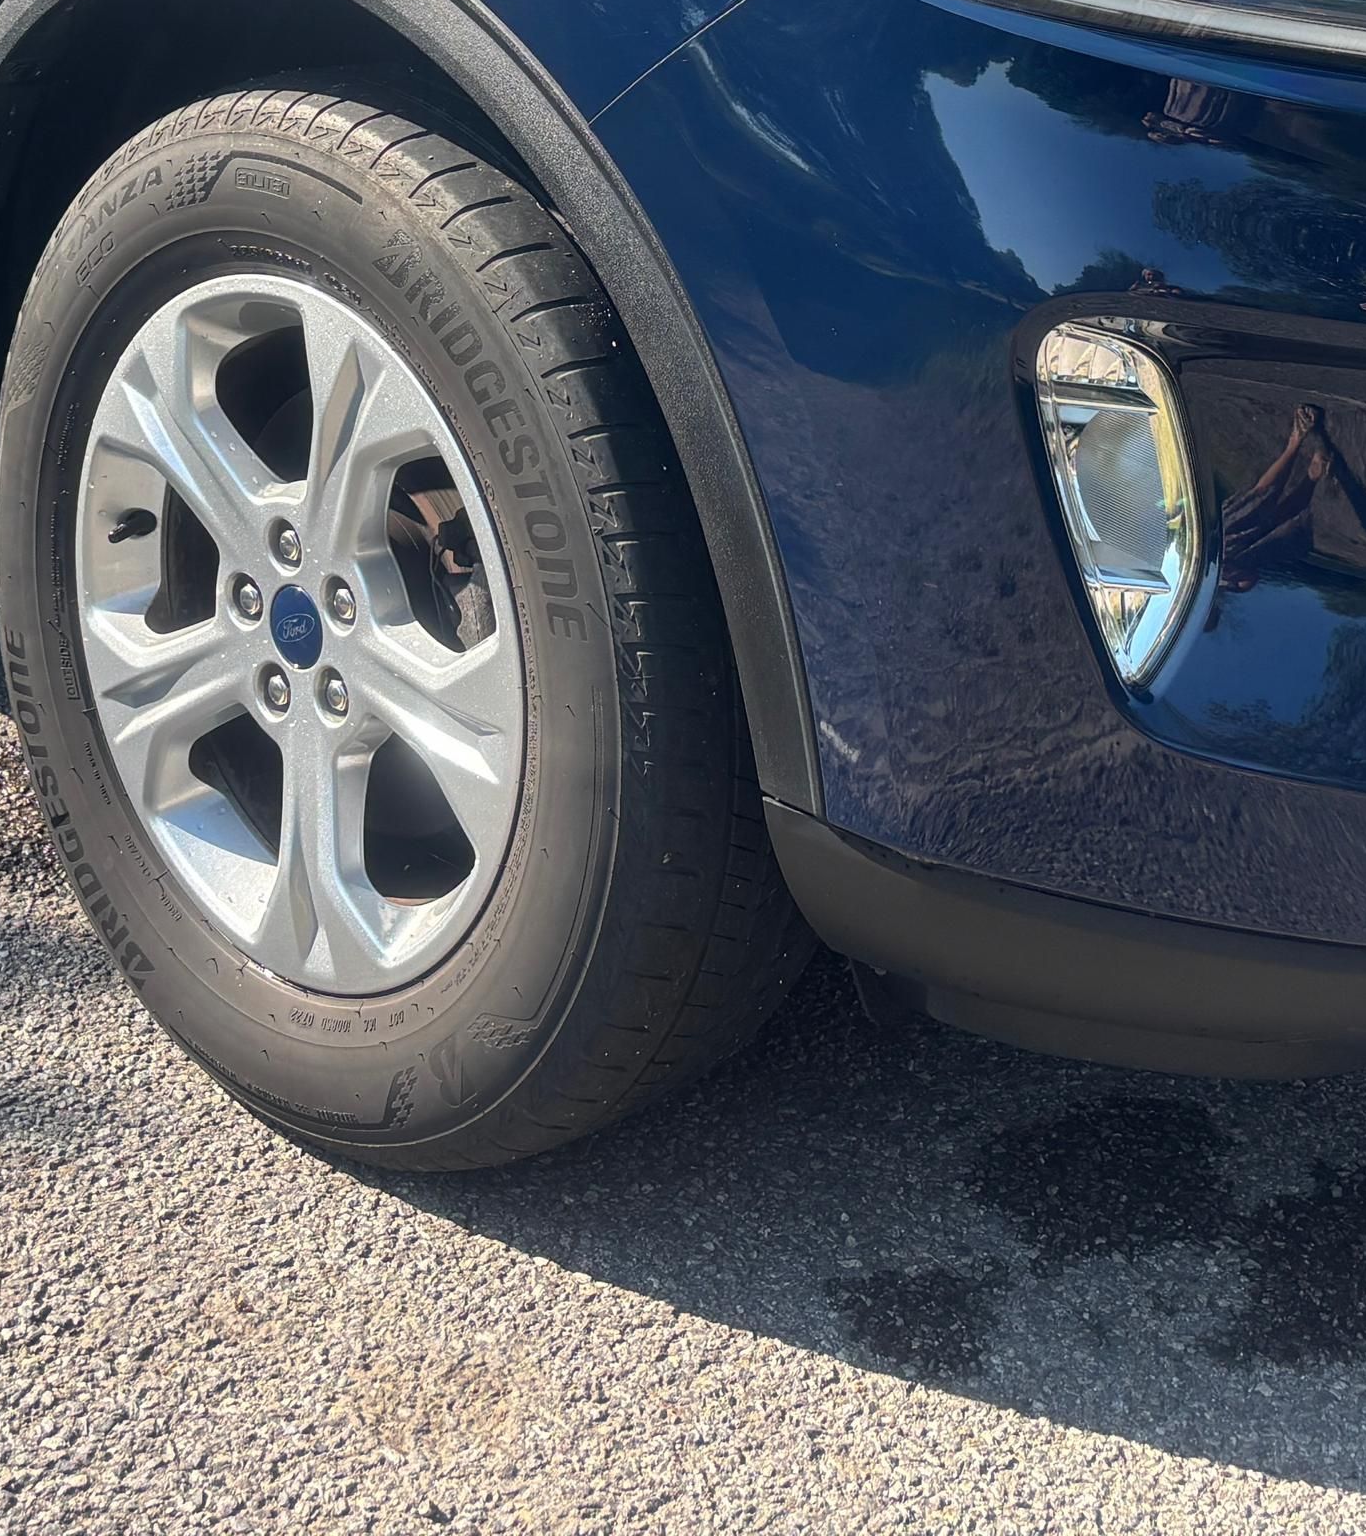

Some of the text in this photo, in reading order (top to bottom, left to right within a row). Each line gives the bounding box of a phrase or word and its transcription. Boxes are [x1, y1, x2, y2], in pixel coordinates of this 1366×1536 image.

[75, 231, 116, 287] ECO
[372, 228, 590, 644] BRIDGESTONE
[282, 618, 308, 640] Ford
[2, 624, 155, 992] BRIDGESTONE
